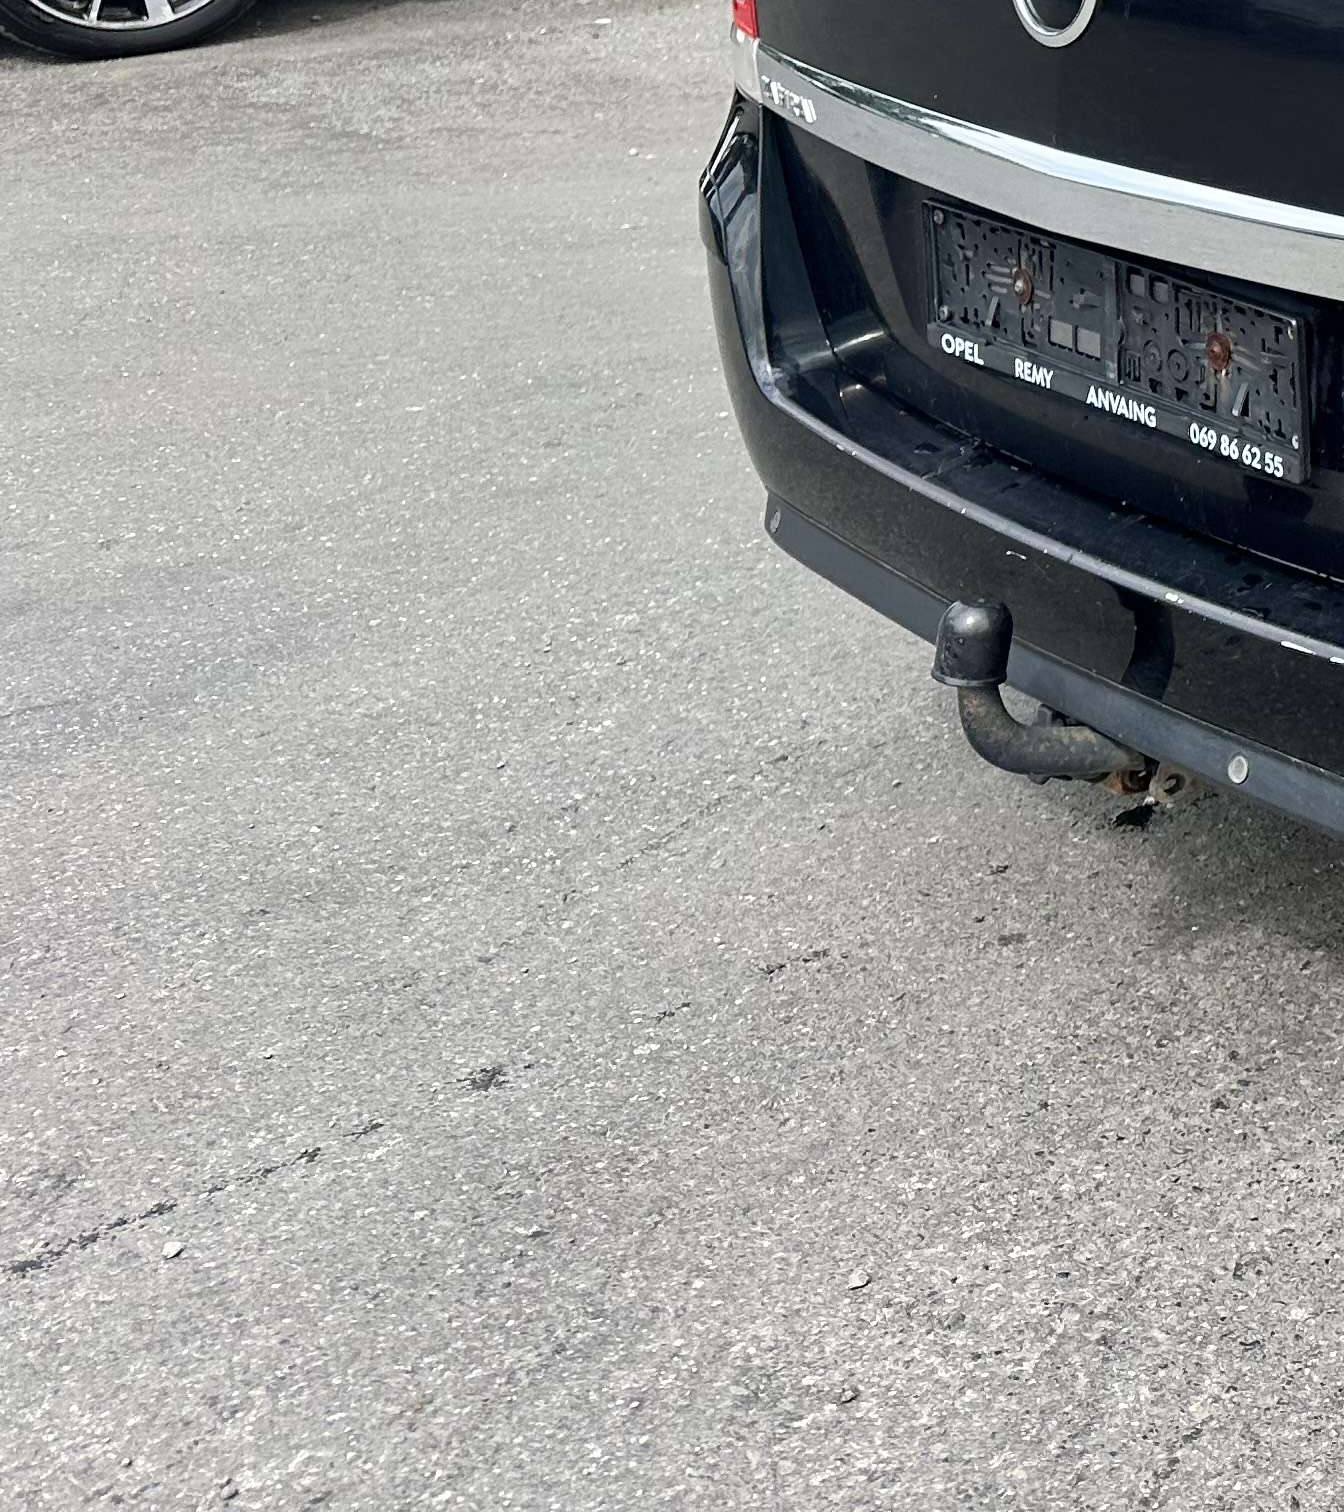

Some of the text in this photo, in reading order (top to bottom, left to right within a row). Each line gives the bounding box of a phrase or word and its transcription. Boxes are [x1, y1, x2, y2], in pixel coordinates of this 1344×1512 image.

[940, 332, 1284, 479] OPEL REMY ANVAING 069 86 62 55
